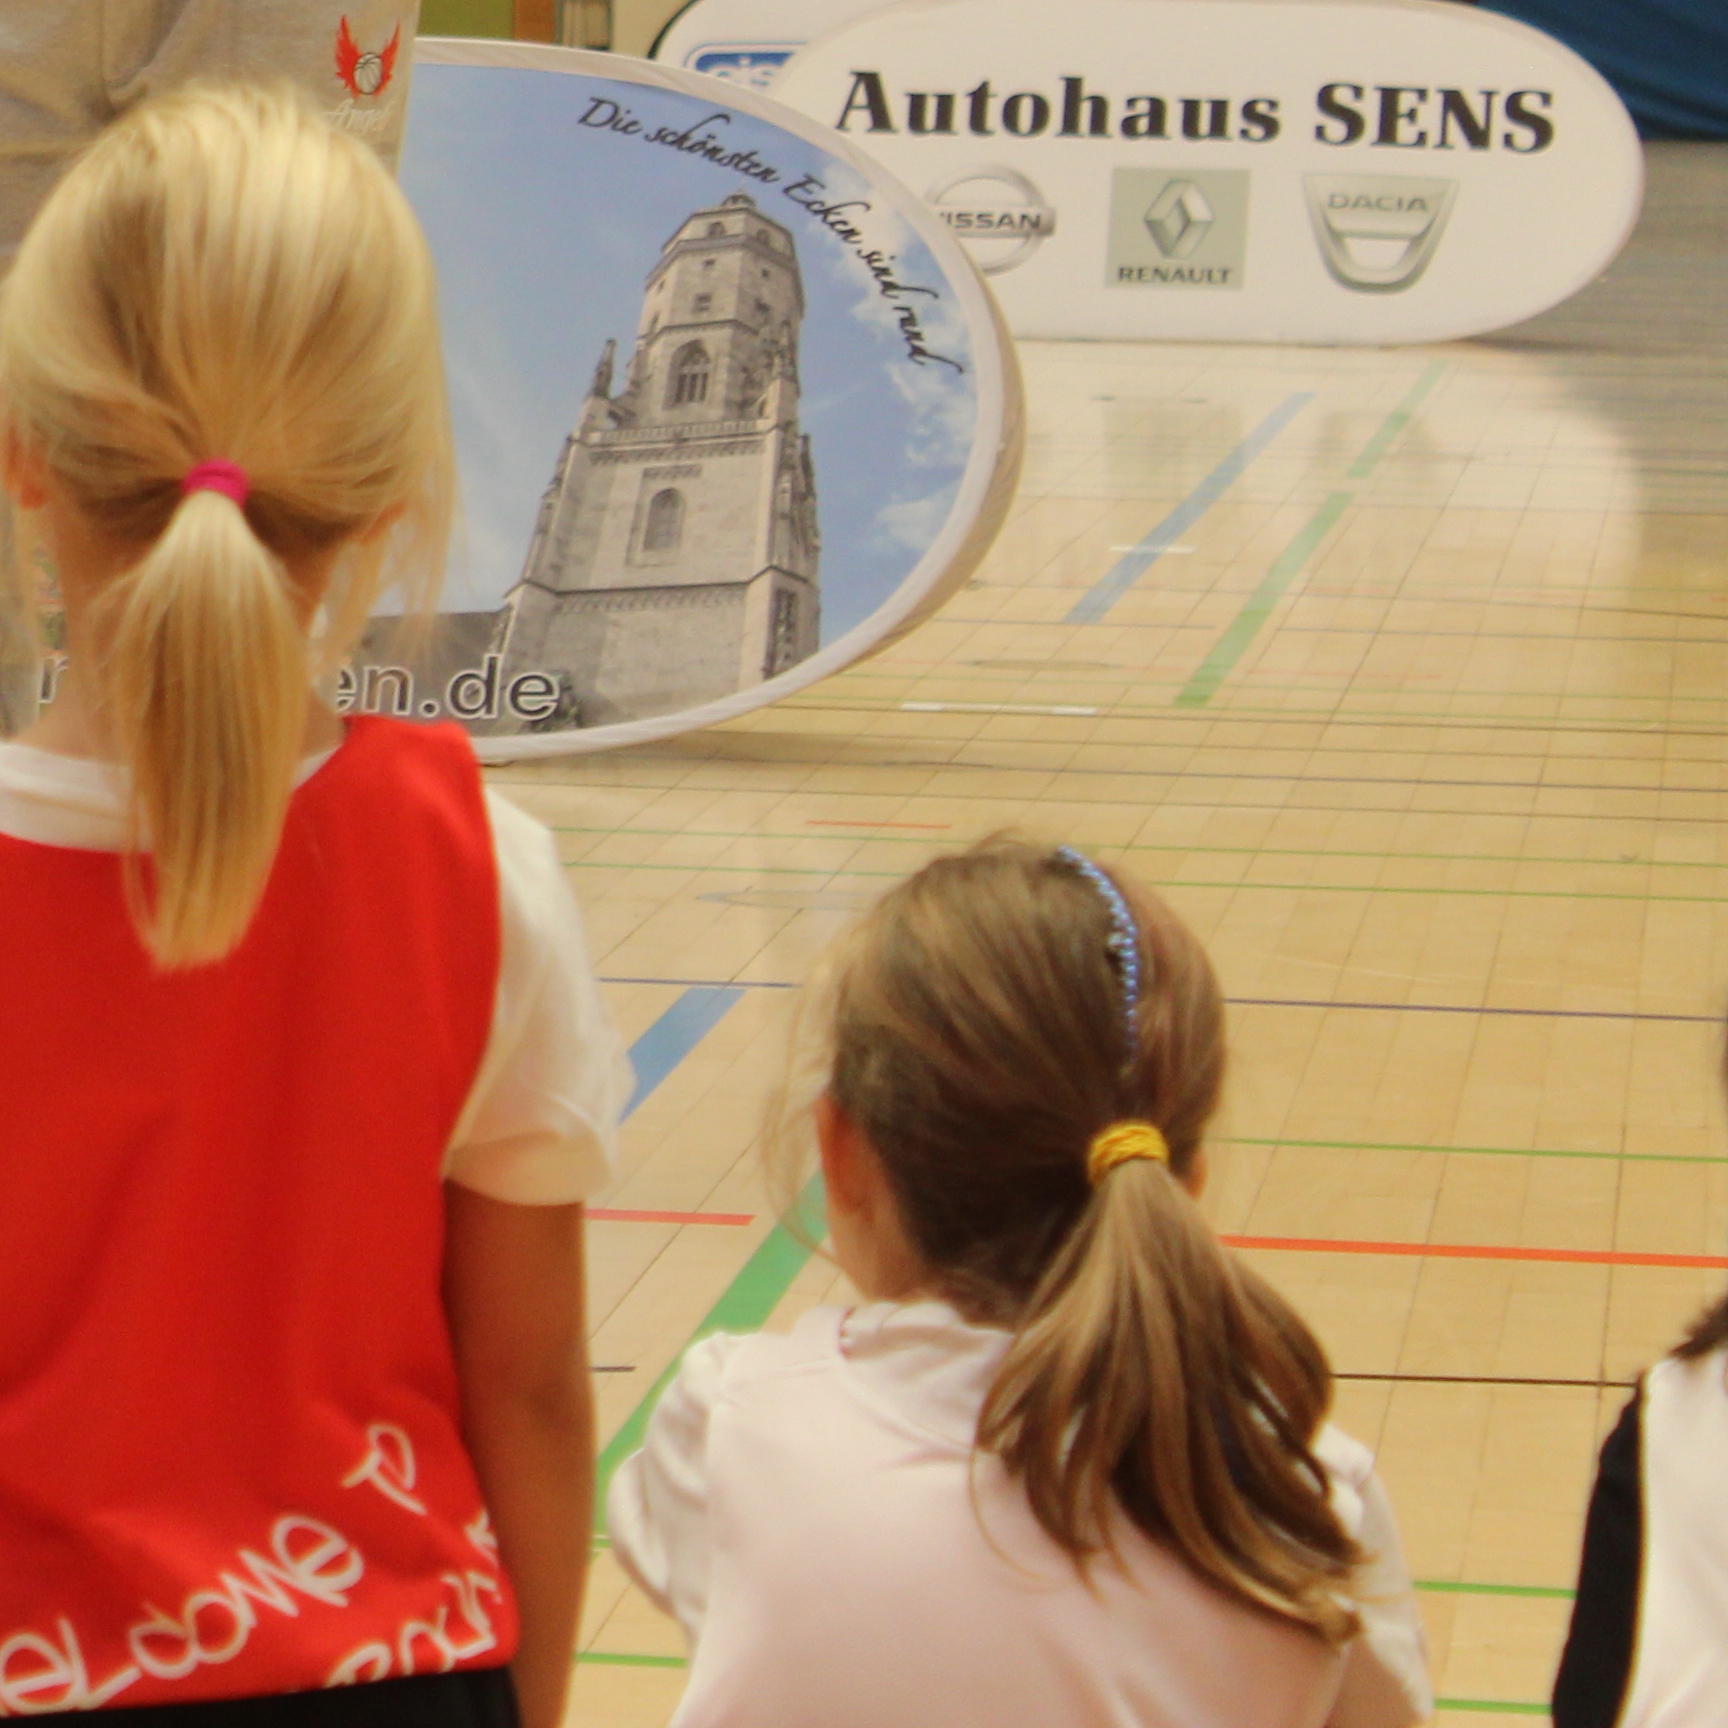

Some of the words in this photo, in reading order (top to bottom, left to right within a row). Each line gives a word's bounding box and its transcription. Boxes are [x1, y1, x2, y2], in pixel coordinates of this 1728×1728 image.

[577, 96, 641, 137] Die
[835, 72, 1280, 145] Autohaus
[1314, 82, 1556, 154] SENS
[644, 112, 780, 184] schönsten
[782, 173, 871, 246] Ecken
[940, 211, 1042, 231] ISSAN
[1327, 193, 1431, 214] DACIA
[856, 248, 939, 300] sind
[1116, 266, 1231, 285] RENAULT
[892, 305, 965, 375] rund
